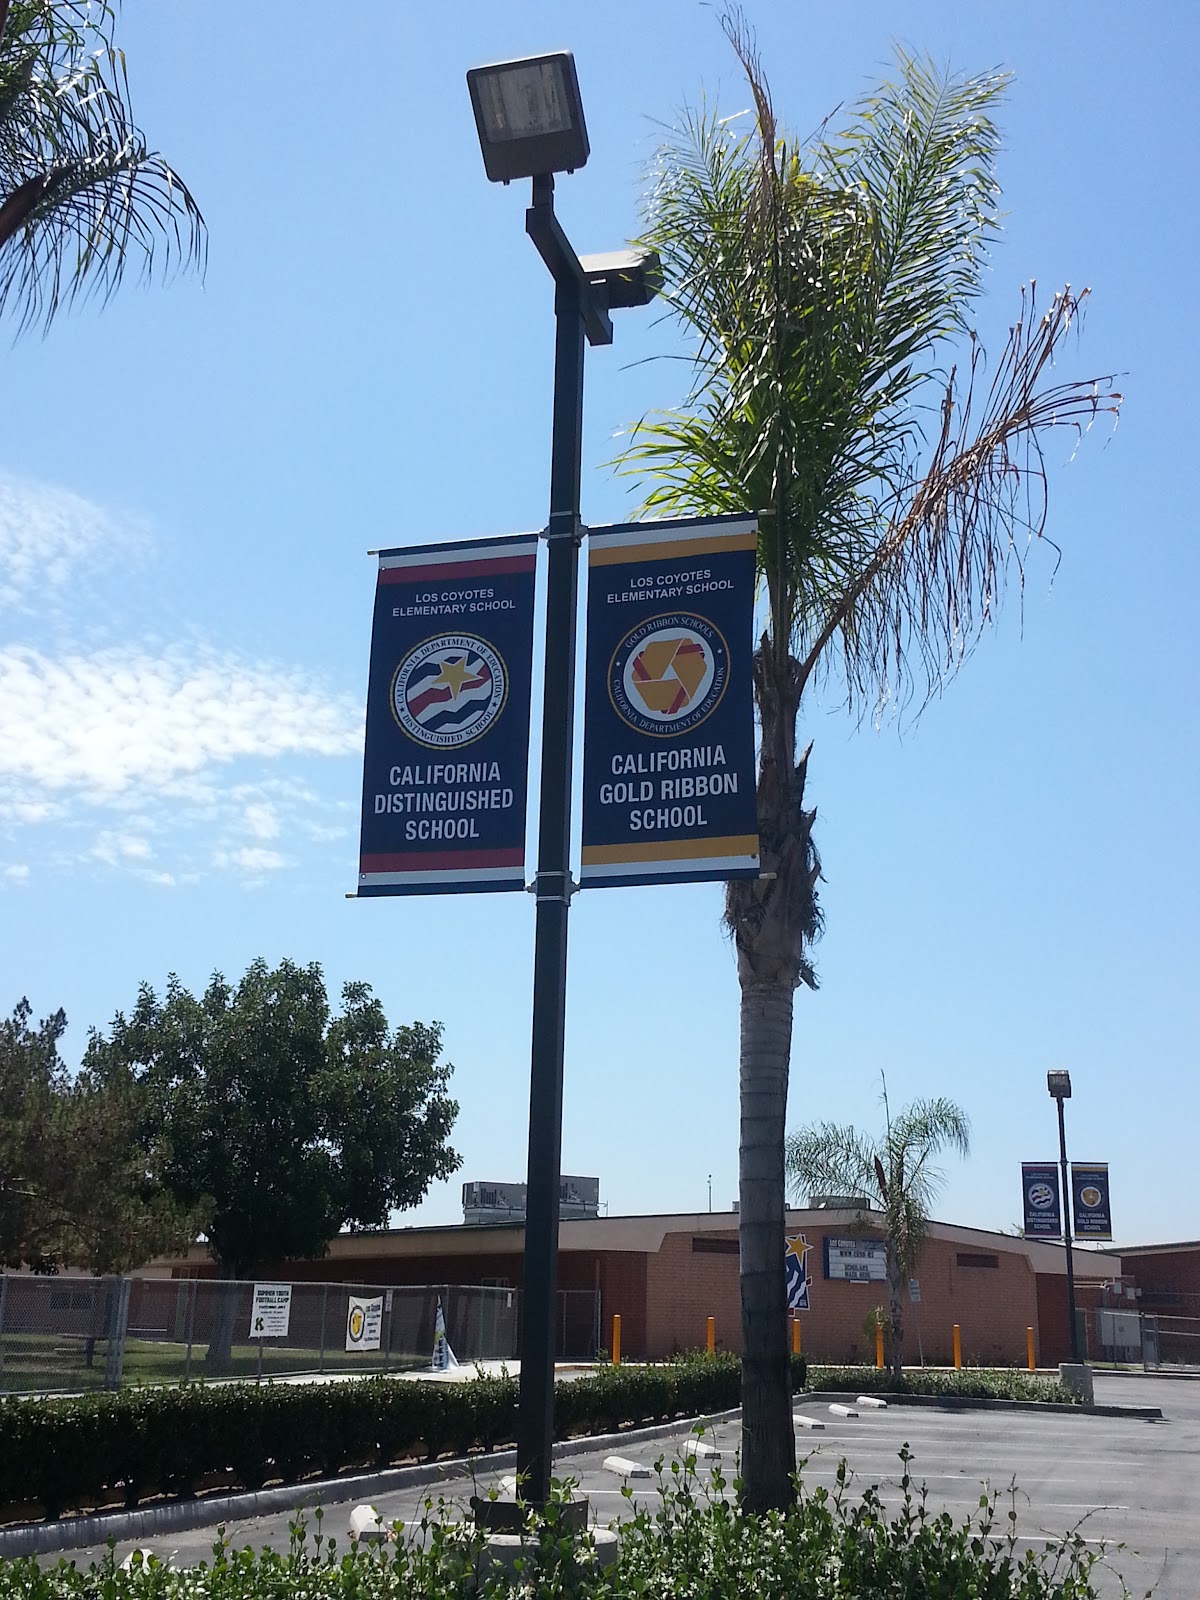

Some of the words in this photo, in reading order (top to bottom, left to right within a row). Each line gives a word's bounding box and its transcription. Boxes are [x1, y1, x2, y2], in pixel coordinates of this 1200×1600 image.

[607, 586, 683, 604] ELEMENTARY
[686, 579, 734, 595] SCHOOL
[631, 577, 653, 588] LOS
[656, 569, 711, 586] COYOTES
[392, 603, 467, 617] ELEMENTARY
[469, 599, 515, 613] SCHOOL
[415, 592, 438, 603] LOS
[441, 588, 494, 602] COYOTES
[625, 627, 646, 648] GOLD
[646, 616, 680, 632] RIBBON
[681, 616, 715, 638] SCHOOLS
[396, 655, 421, 704] CALIFORNIA
[420, 638, 477, 656] DEPARTMENT
[476, 645, 488, 655] OF
[486, 654, 502, 699] EDUCATION
[613, 679, 638, 723] CALIFORNIA
[638, 718, 692, 733] DEPARTMENT
[691, 712, 701, 722] OF
[701, 667, 725, 713] EDUCATION
[402, 714, 463, 743] DISTINGUISHED
[465, 710, 495, 737] SCHOOL
[611, 744, 727, 775] CALIFORNIA
[389, 761, 501, 786] CALIFORNIA
[374, 788, 514, 814] DISTINGUISHED
[600, 781, 654, 805] GOLD
[661, 772, 738, 800] RIBBON
[405, 818, 480, 840] SCHOOL
[629, 804, 708, 831] SCHOOL
